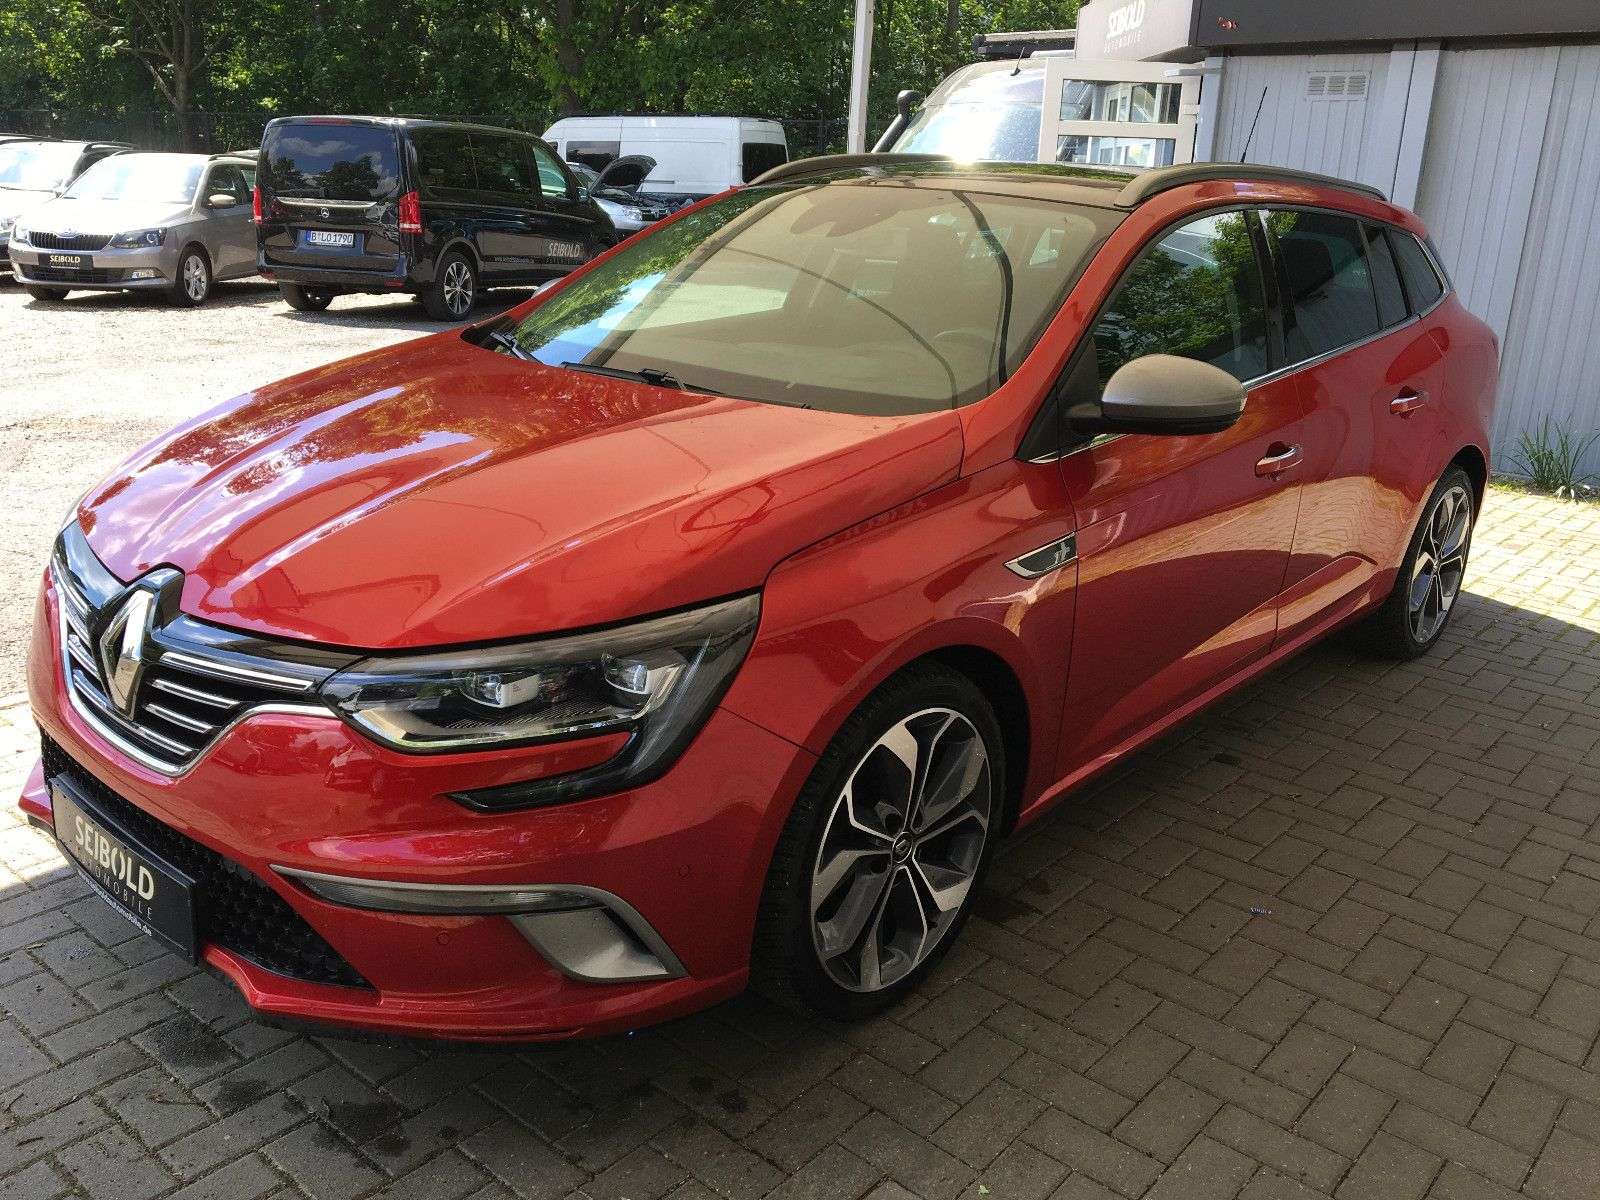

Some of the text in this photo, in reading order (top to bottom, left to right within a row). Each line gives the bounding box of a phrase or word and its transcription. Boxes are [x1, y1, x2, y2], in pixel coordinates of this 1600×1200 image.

[50, 255, 81, 263] SEIBOLD
[547, 242, 581, 258] SEIBOLD
[75, 815, 155, 901] SEIBOLD
[78, 850, 153, 921] OMOBILE
